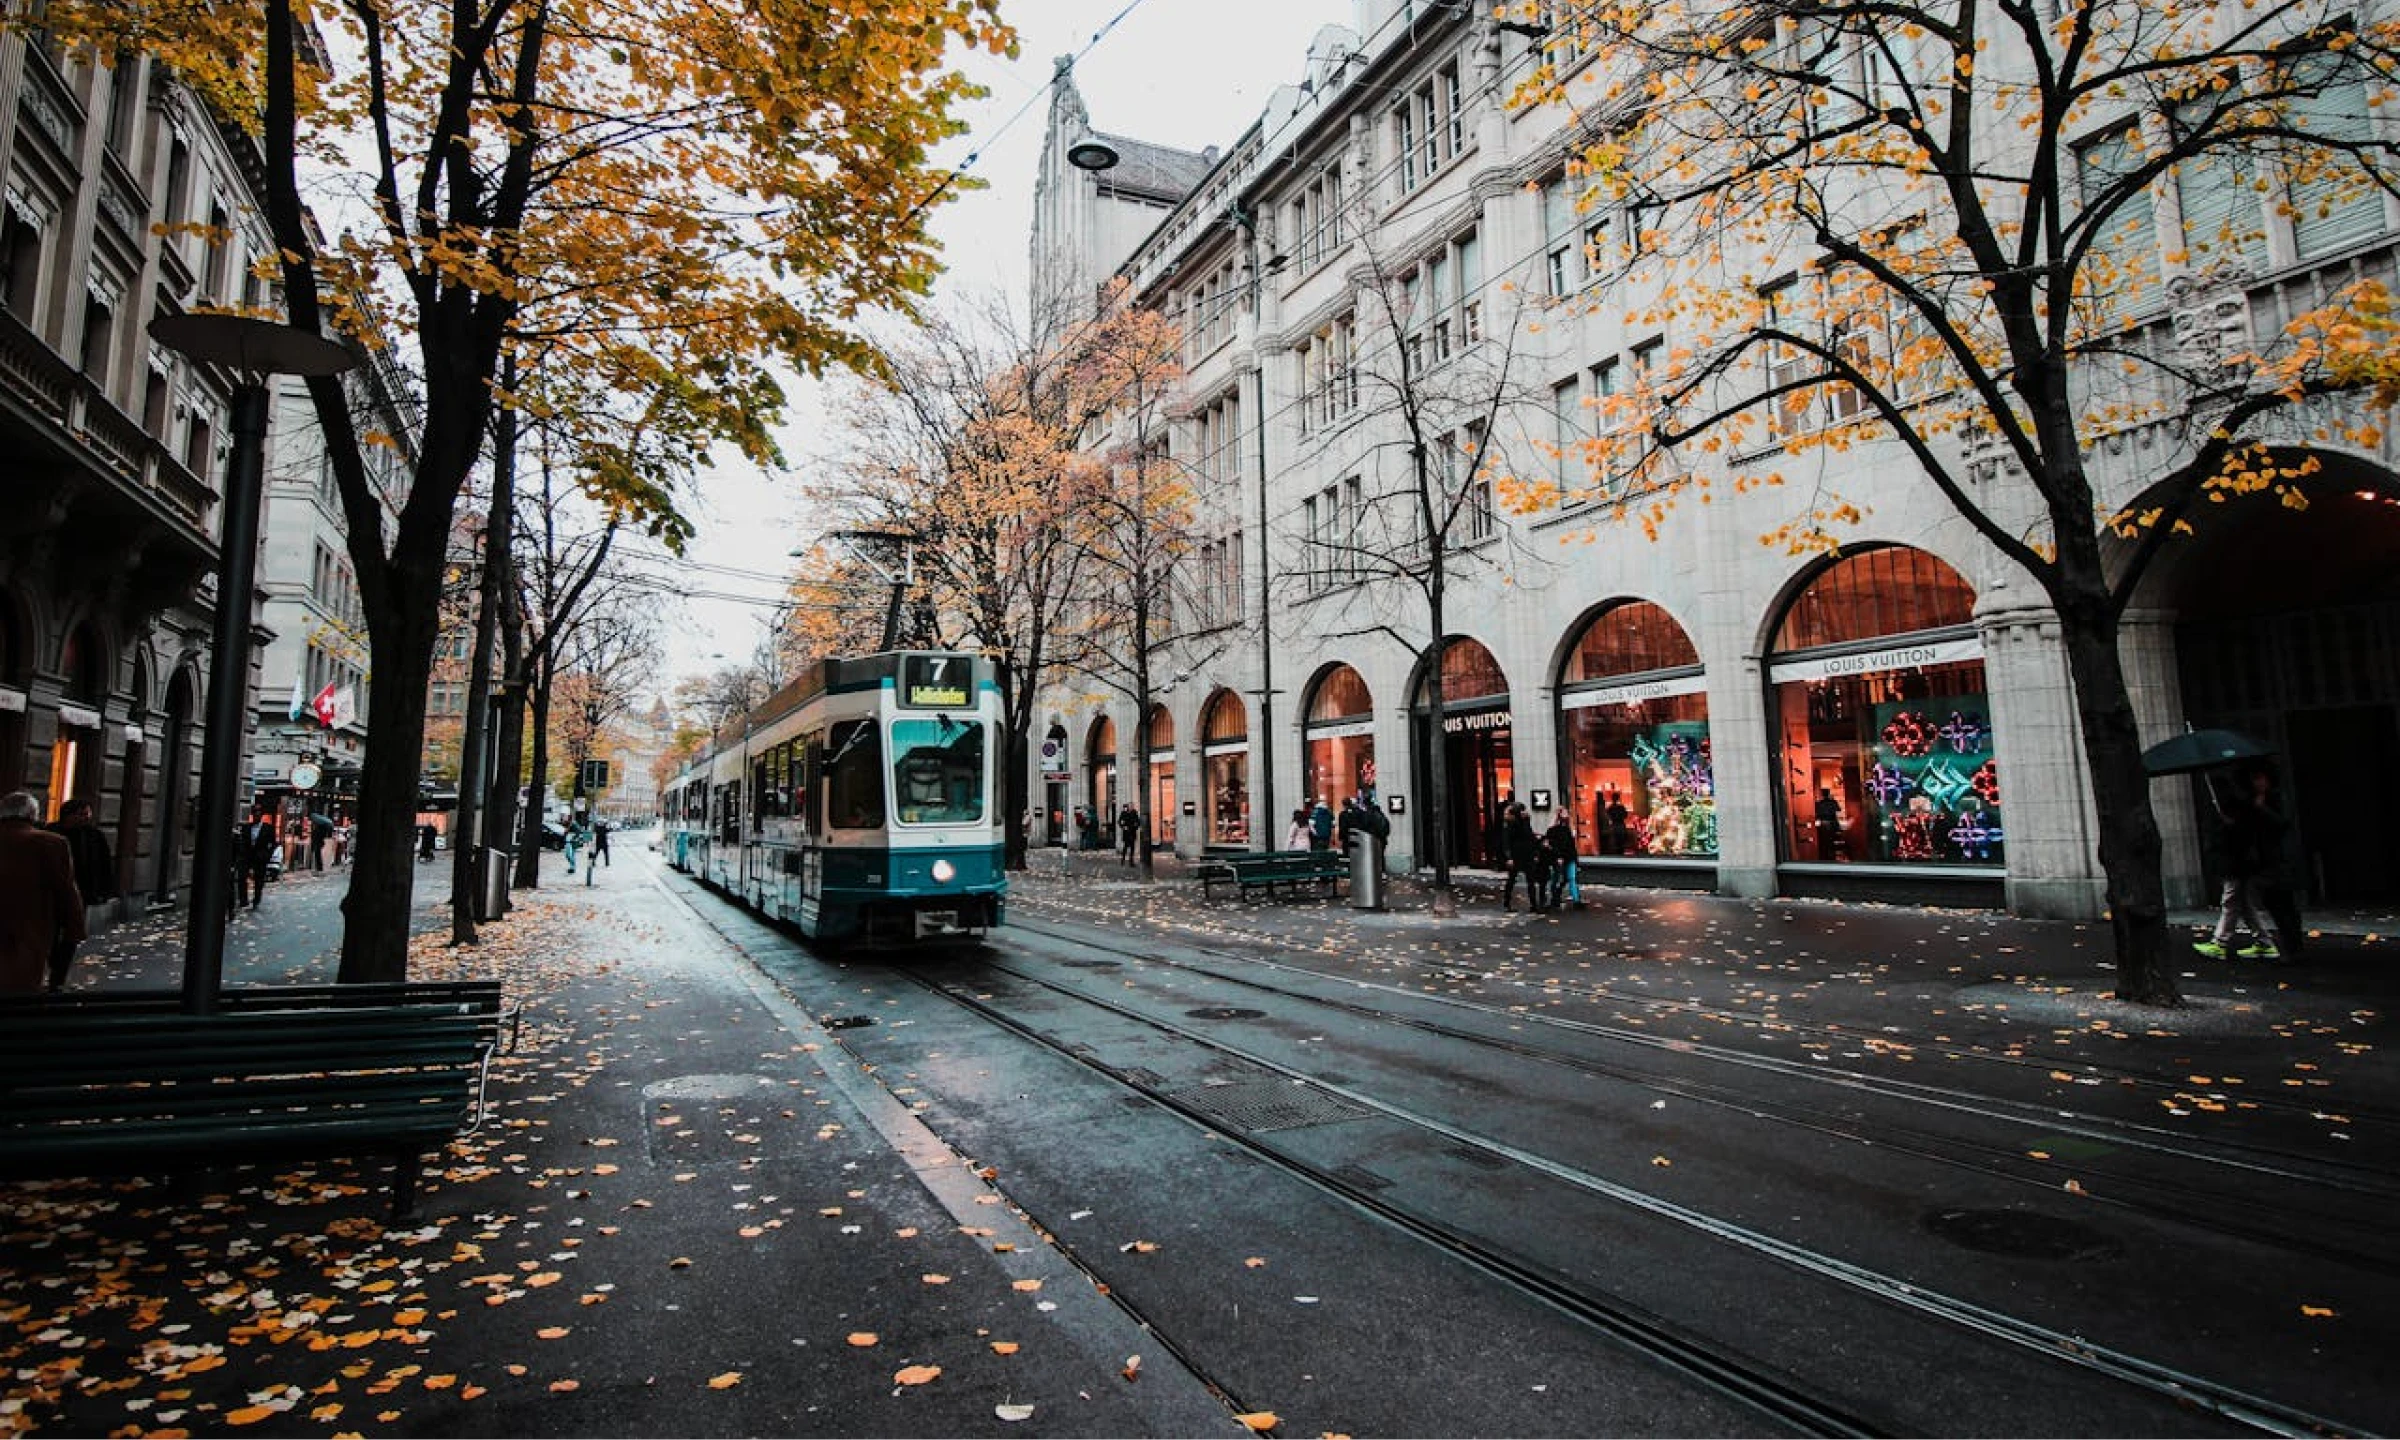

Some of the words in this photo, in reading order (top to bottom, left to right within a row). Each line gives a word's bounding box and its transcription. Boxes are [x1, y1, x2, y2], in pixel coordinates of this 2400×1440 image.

[930, 658, 947, 681] 7
[1824, 657, 1864, 673] LOUIS
[1870, 648, 1935, 666] VUITTON
[1443, 716, 1463, 733] UIS
